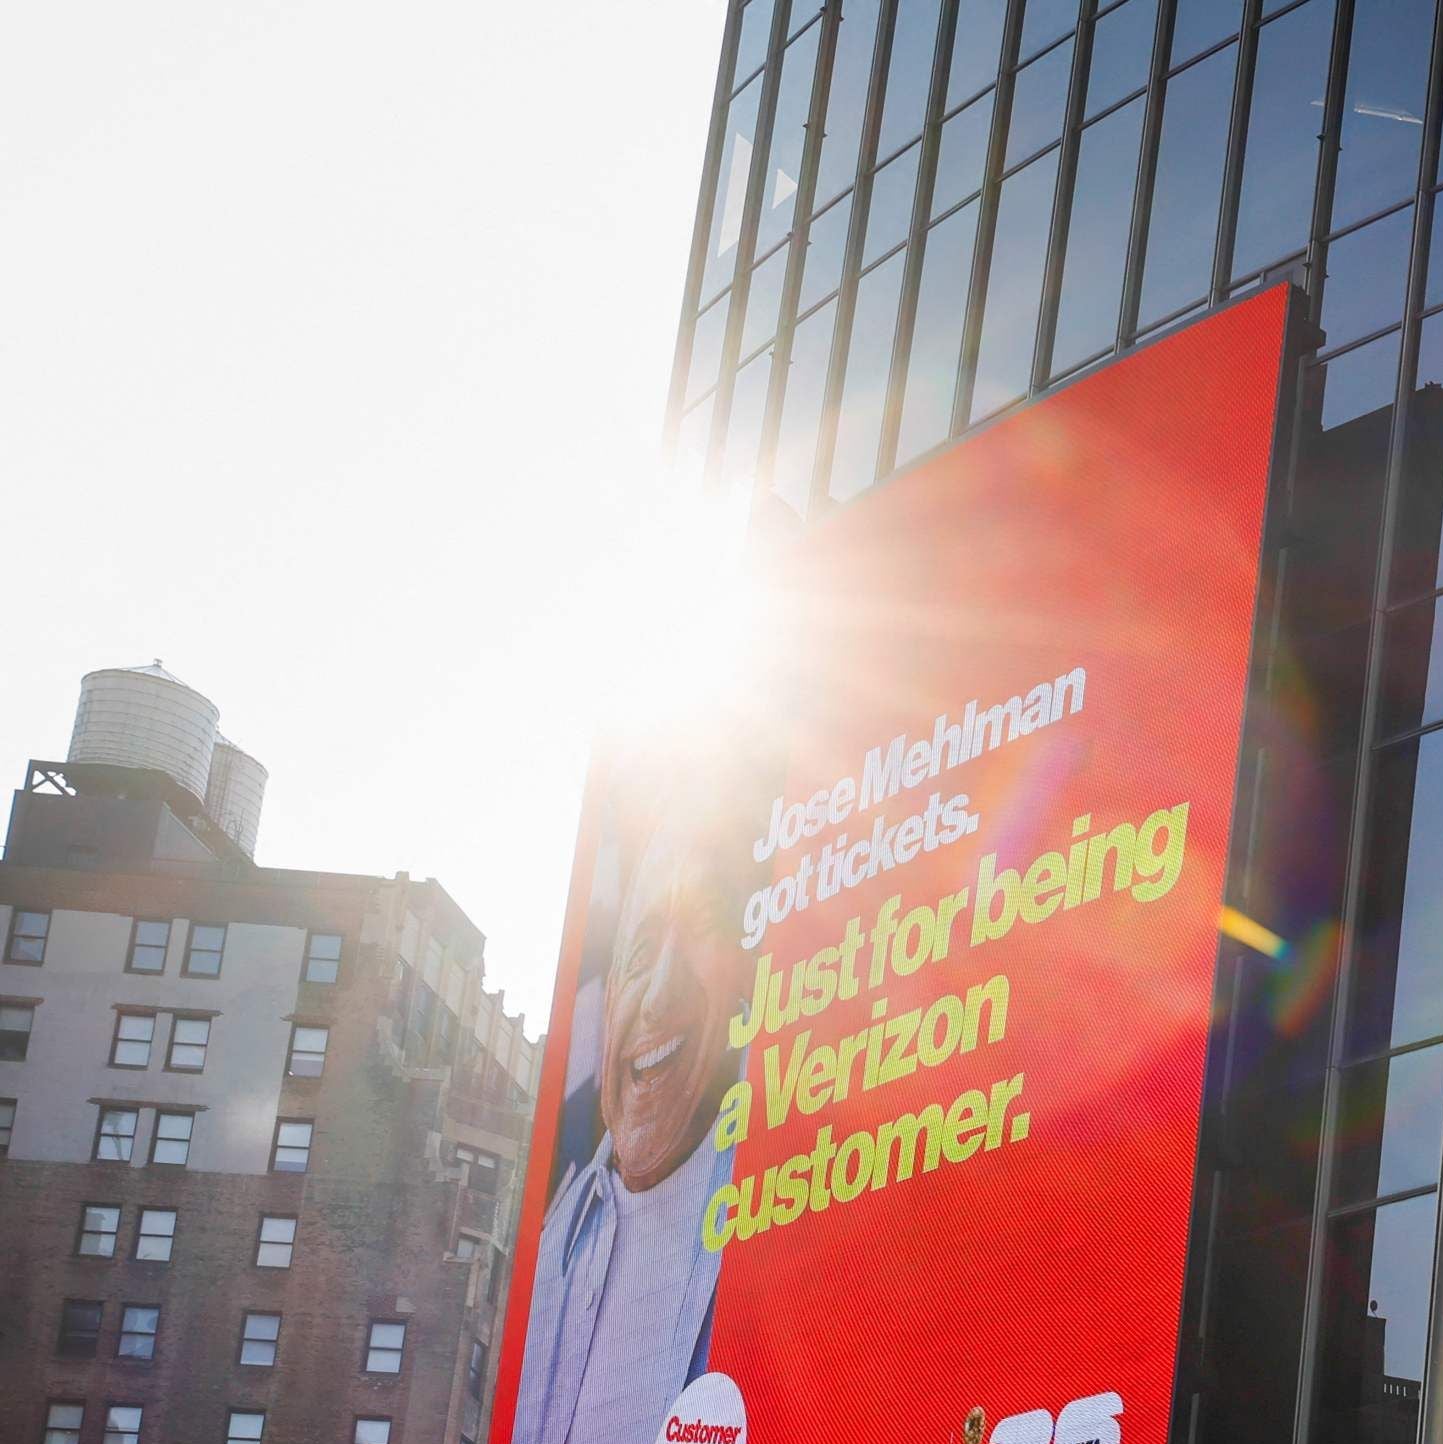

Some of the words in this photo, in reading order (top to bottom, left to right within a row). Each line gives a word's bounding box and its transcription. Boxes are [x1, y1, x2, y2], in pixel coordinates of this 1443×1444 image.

[753, 773, 861, 862] Jose
[858, 667, 1086, 808] Mehlman
[729, 916, 863, 1049] Just
[868, 887, 970, 990] for
[970, 802, 1190, 947] being
[740, 858, 815, 949] got
[817, 792, 980, 902] tickets.
[714, 1079, 752, 1152] a
[763, 974, 1010, 1130] Verizon
[702, 1072, 1031, 1253] customer.
